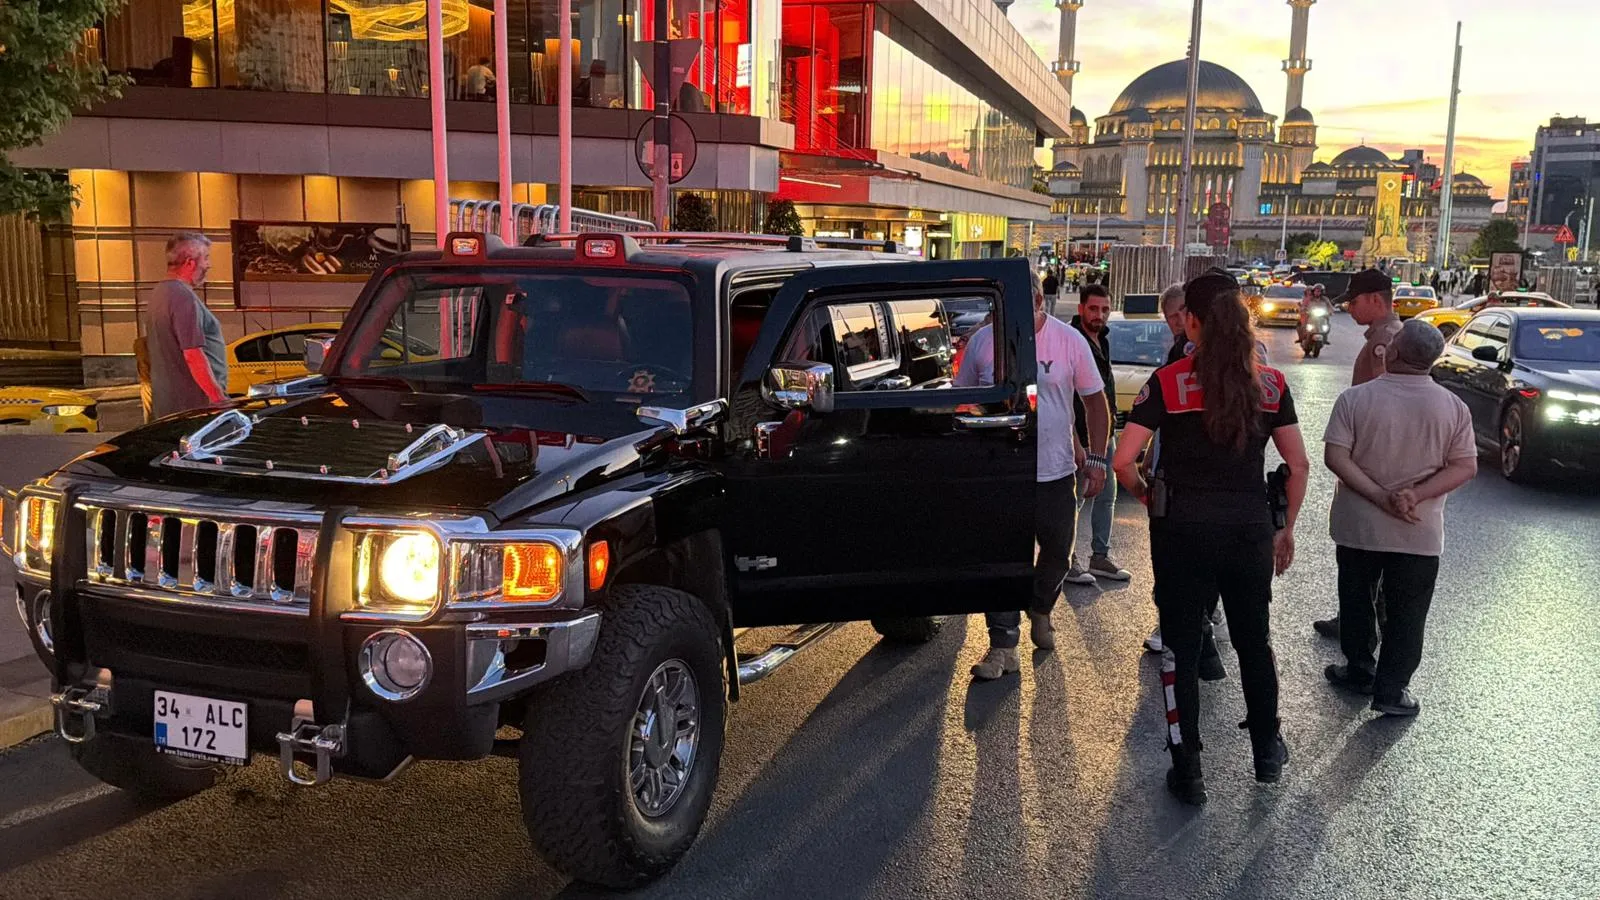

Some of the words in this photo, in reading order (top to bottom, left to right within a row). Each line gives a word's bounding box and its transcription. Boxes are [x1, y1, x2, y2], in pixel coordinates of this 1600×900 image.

[158, 696, 180, 719] 34
[205, 703, 243, 729] ALC
[182, 726, 216, 750] 172
